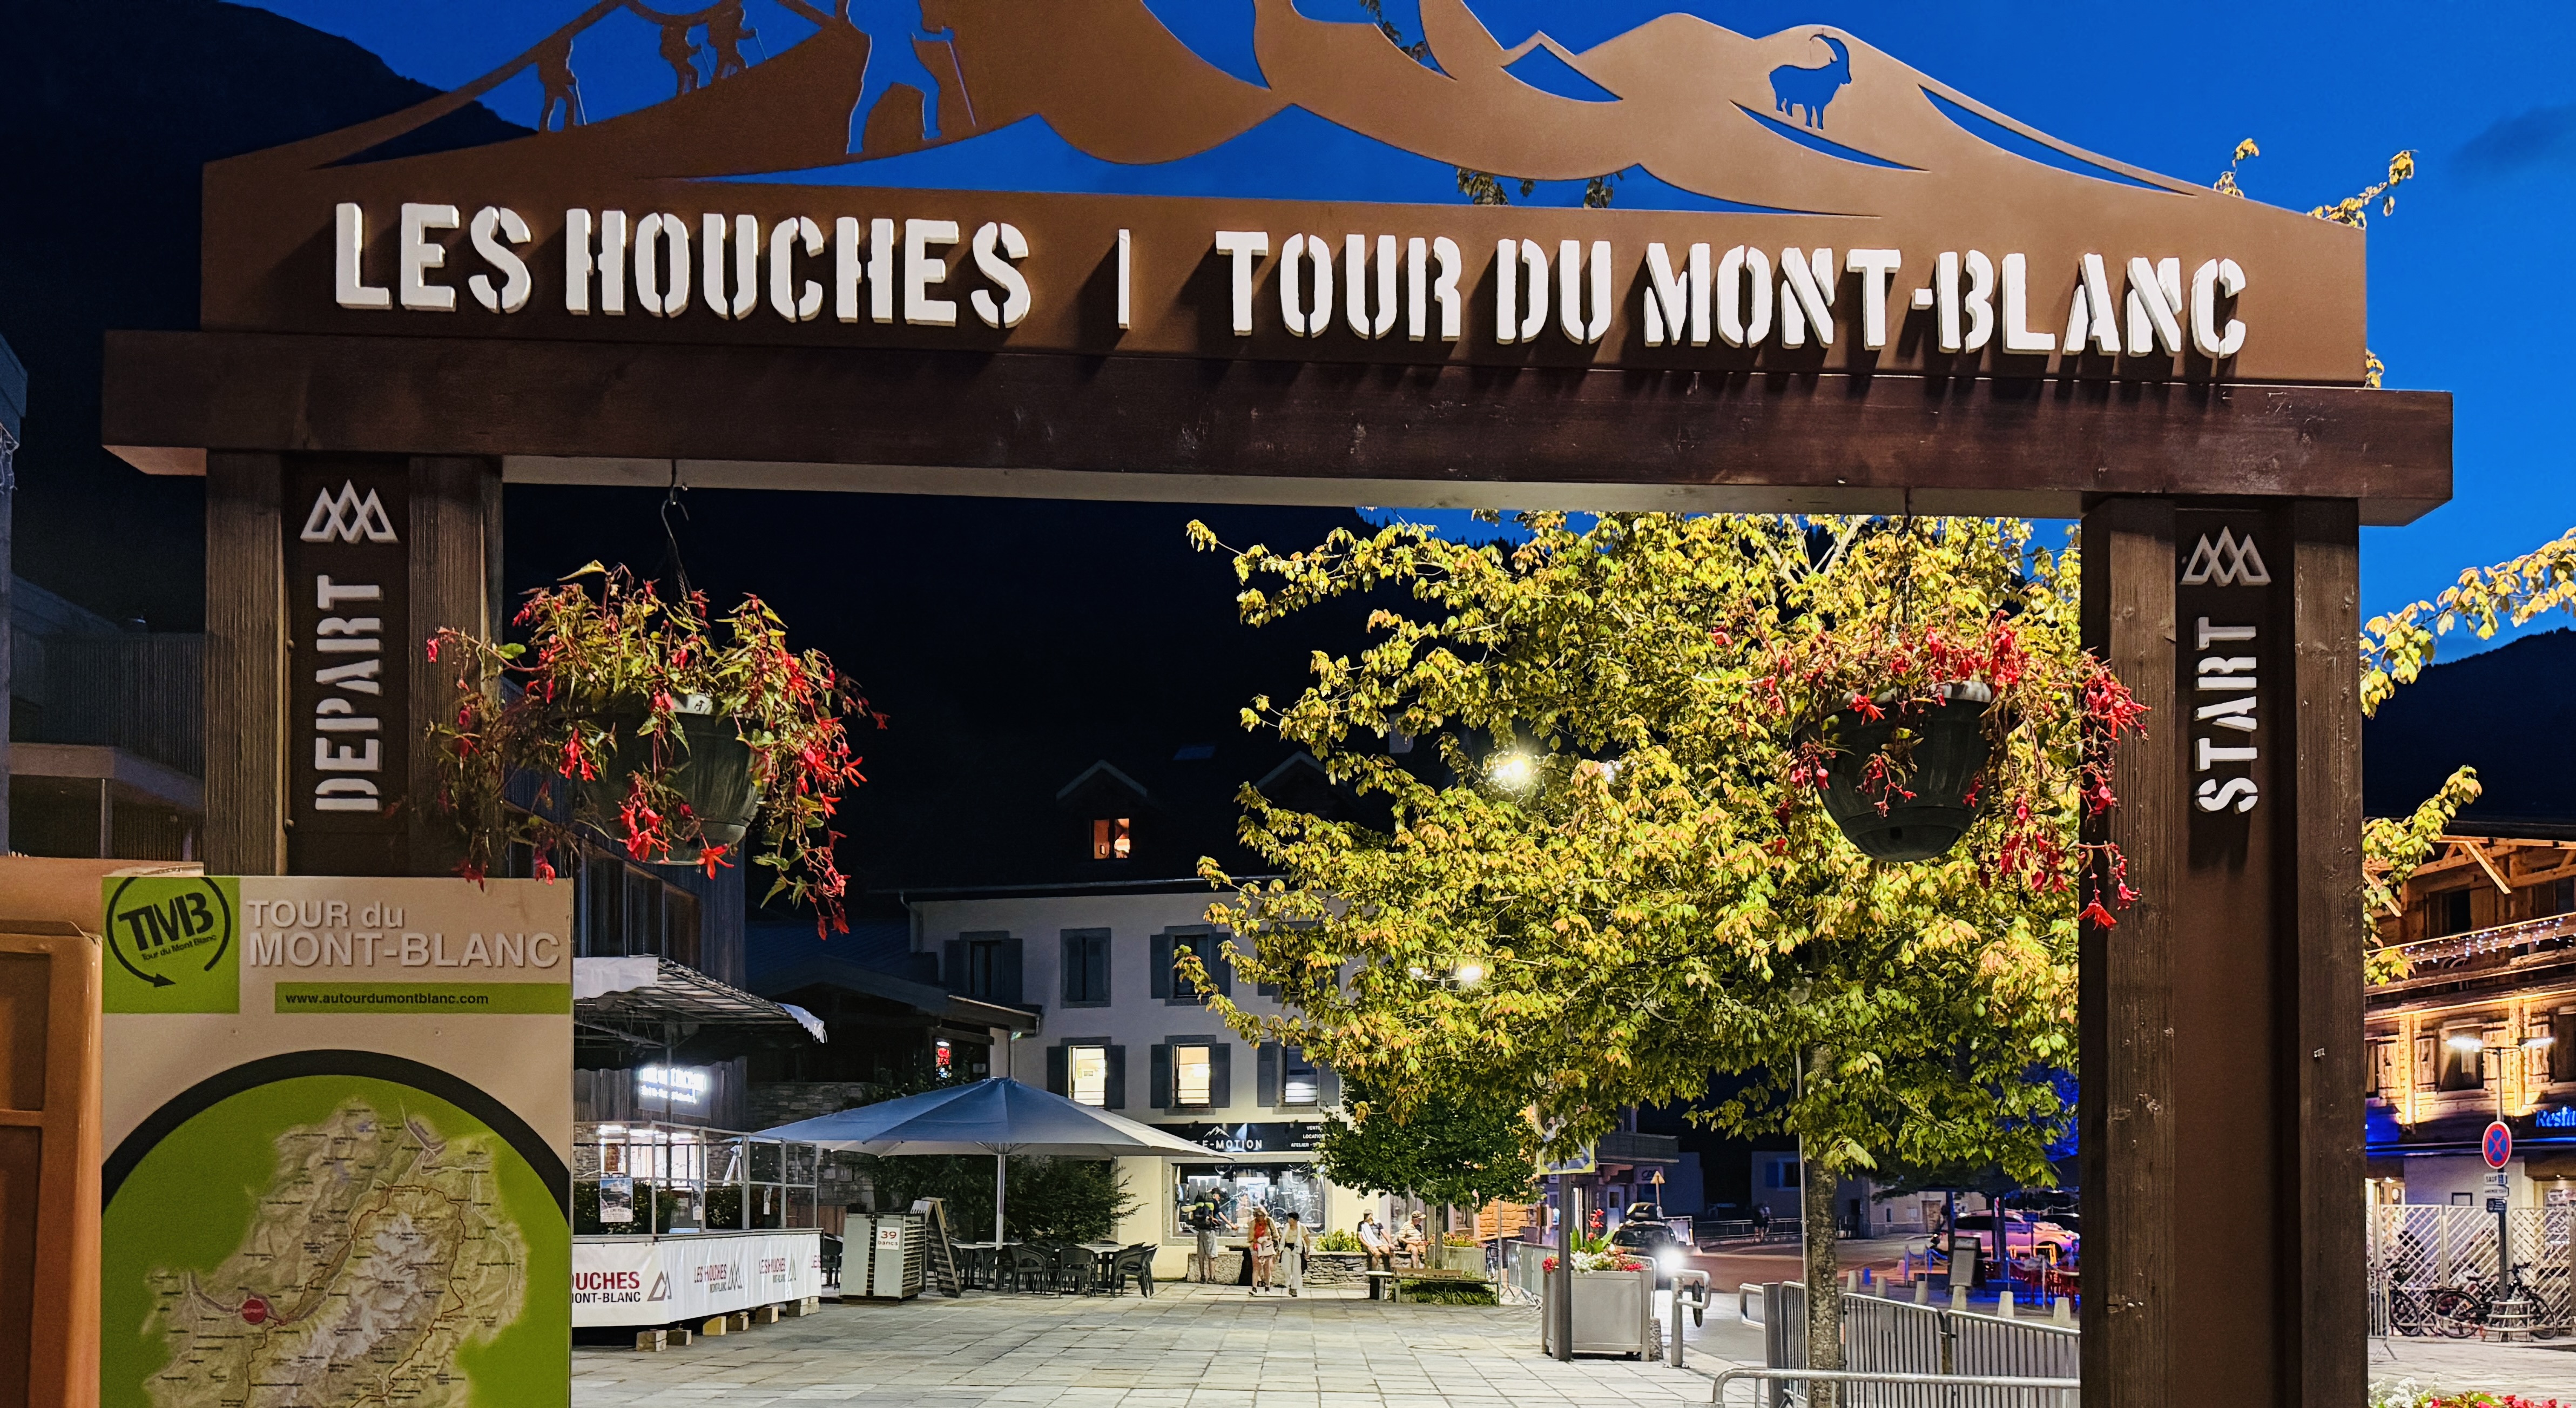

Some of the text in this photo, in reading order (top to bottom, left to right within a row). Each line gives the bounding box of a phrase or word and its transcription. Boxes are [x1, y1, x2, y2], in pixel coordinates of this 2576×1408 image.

[335, 203, 531, 314] LES
[566, 209, 1031, 329] HOUCHES
[1215, 231, 1462, 343] TOUR
[1497, 238, 1613, 346] DU
[1644, 242, 2247, 359] MONT-BLANC
[315, 575, 381, 811] DEPART
[2195, 616, 2258, 813] START
[117, 892, 214, 951] TMB
[247, 899, 404, 928] TOUR du
[141, 935, 217, 961] Tour du Mont Blanc
[247, 932, 561, 968] MONT-BLANC
[285, 992, 489, 1007] www.autourdumontblanc.com
[881, 1231, 897, 1239] 39
[571, 1271, 640, 1290] UCHES
